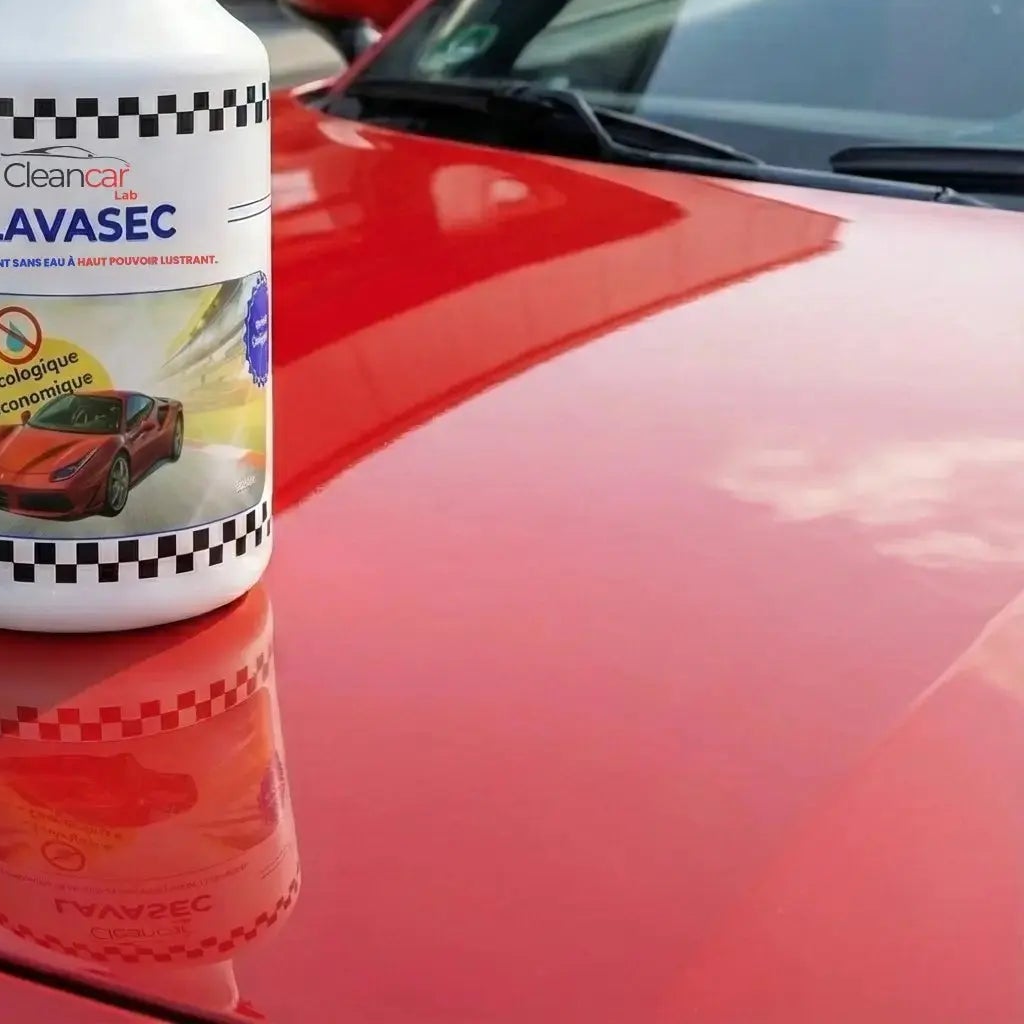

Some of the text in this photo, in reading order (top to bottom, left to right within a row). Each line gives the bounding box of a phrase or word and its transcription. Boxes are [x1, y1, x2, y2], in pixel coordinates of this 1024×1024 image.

[3, 161, 130, 188] Cleancar
[114, 190, 138, 201] Lab
[12, 258, 42, 268] SANS
[43, 257, 65, 267] EAU
[67, 255, 76, 267] À
[77, 257, 107, 267] HAUT
[109, 256, 158, 266] POUVOIR
[160, 255, 219, 265] LUSTRANT.
